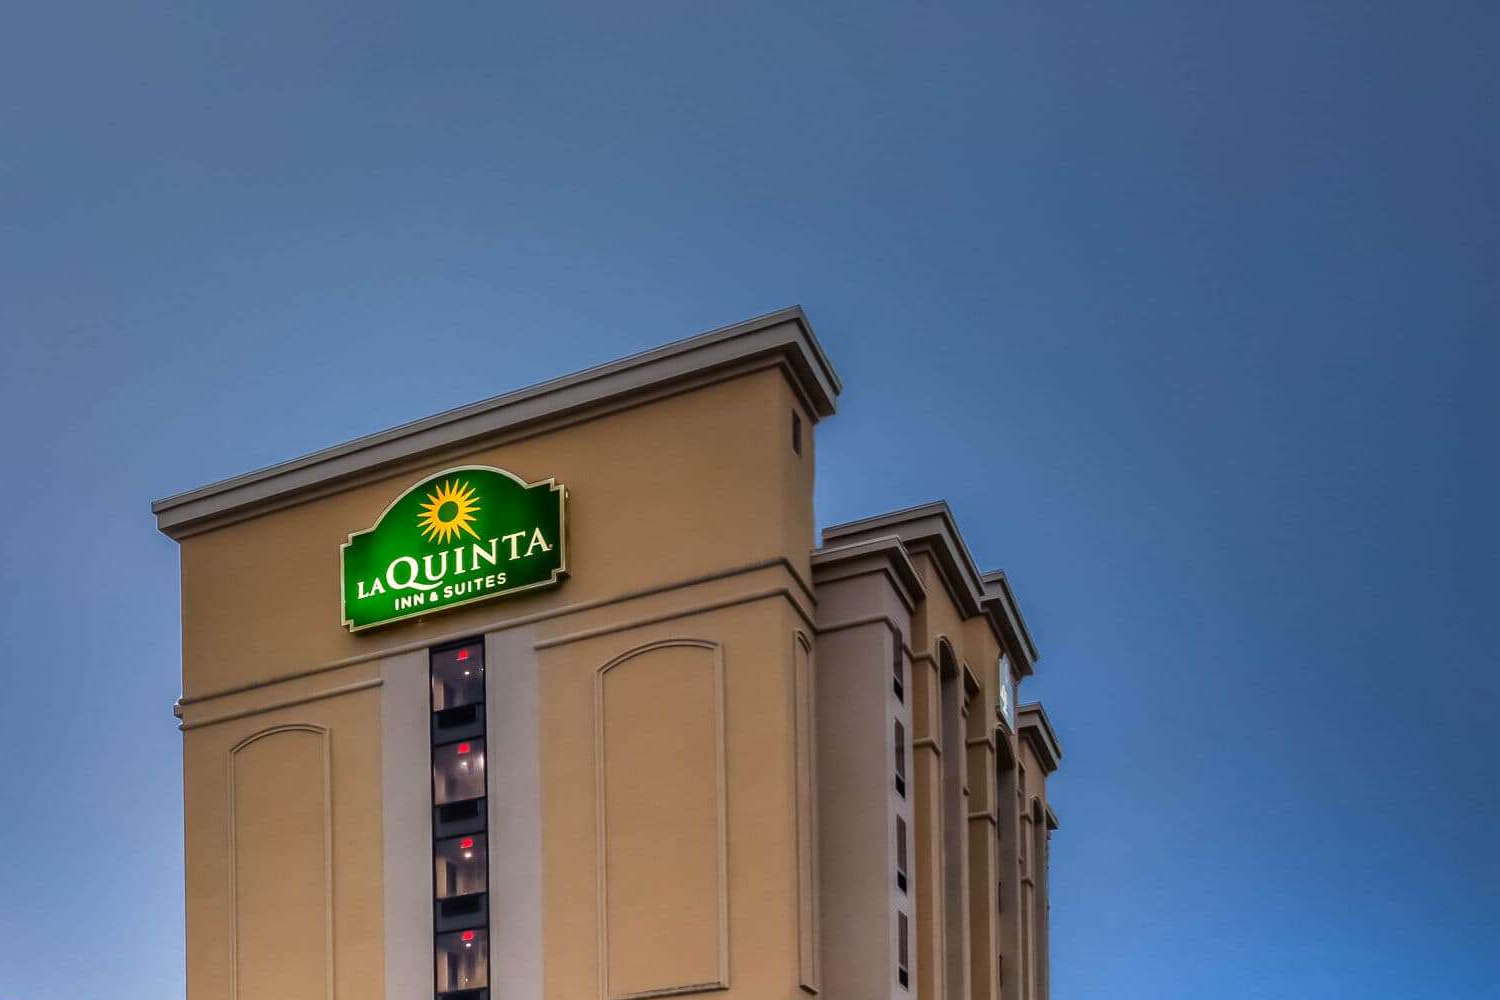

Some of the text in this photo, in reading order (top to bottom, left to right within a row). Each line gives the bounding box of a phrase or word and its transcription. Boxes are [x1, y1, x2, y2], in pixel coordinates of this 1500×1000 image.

[357, 527, 551, 599] LA QUINTA
[394, 572, 507, 610] INN & SUITES
